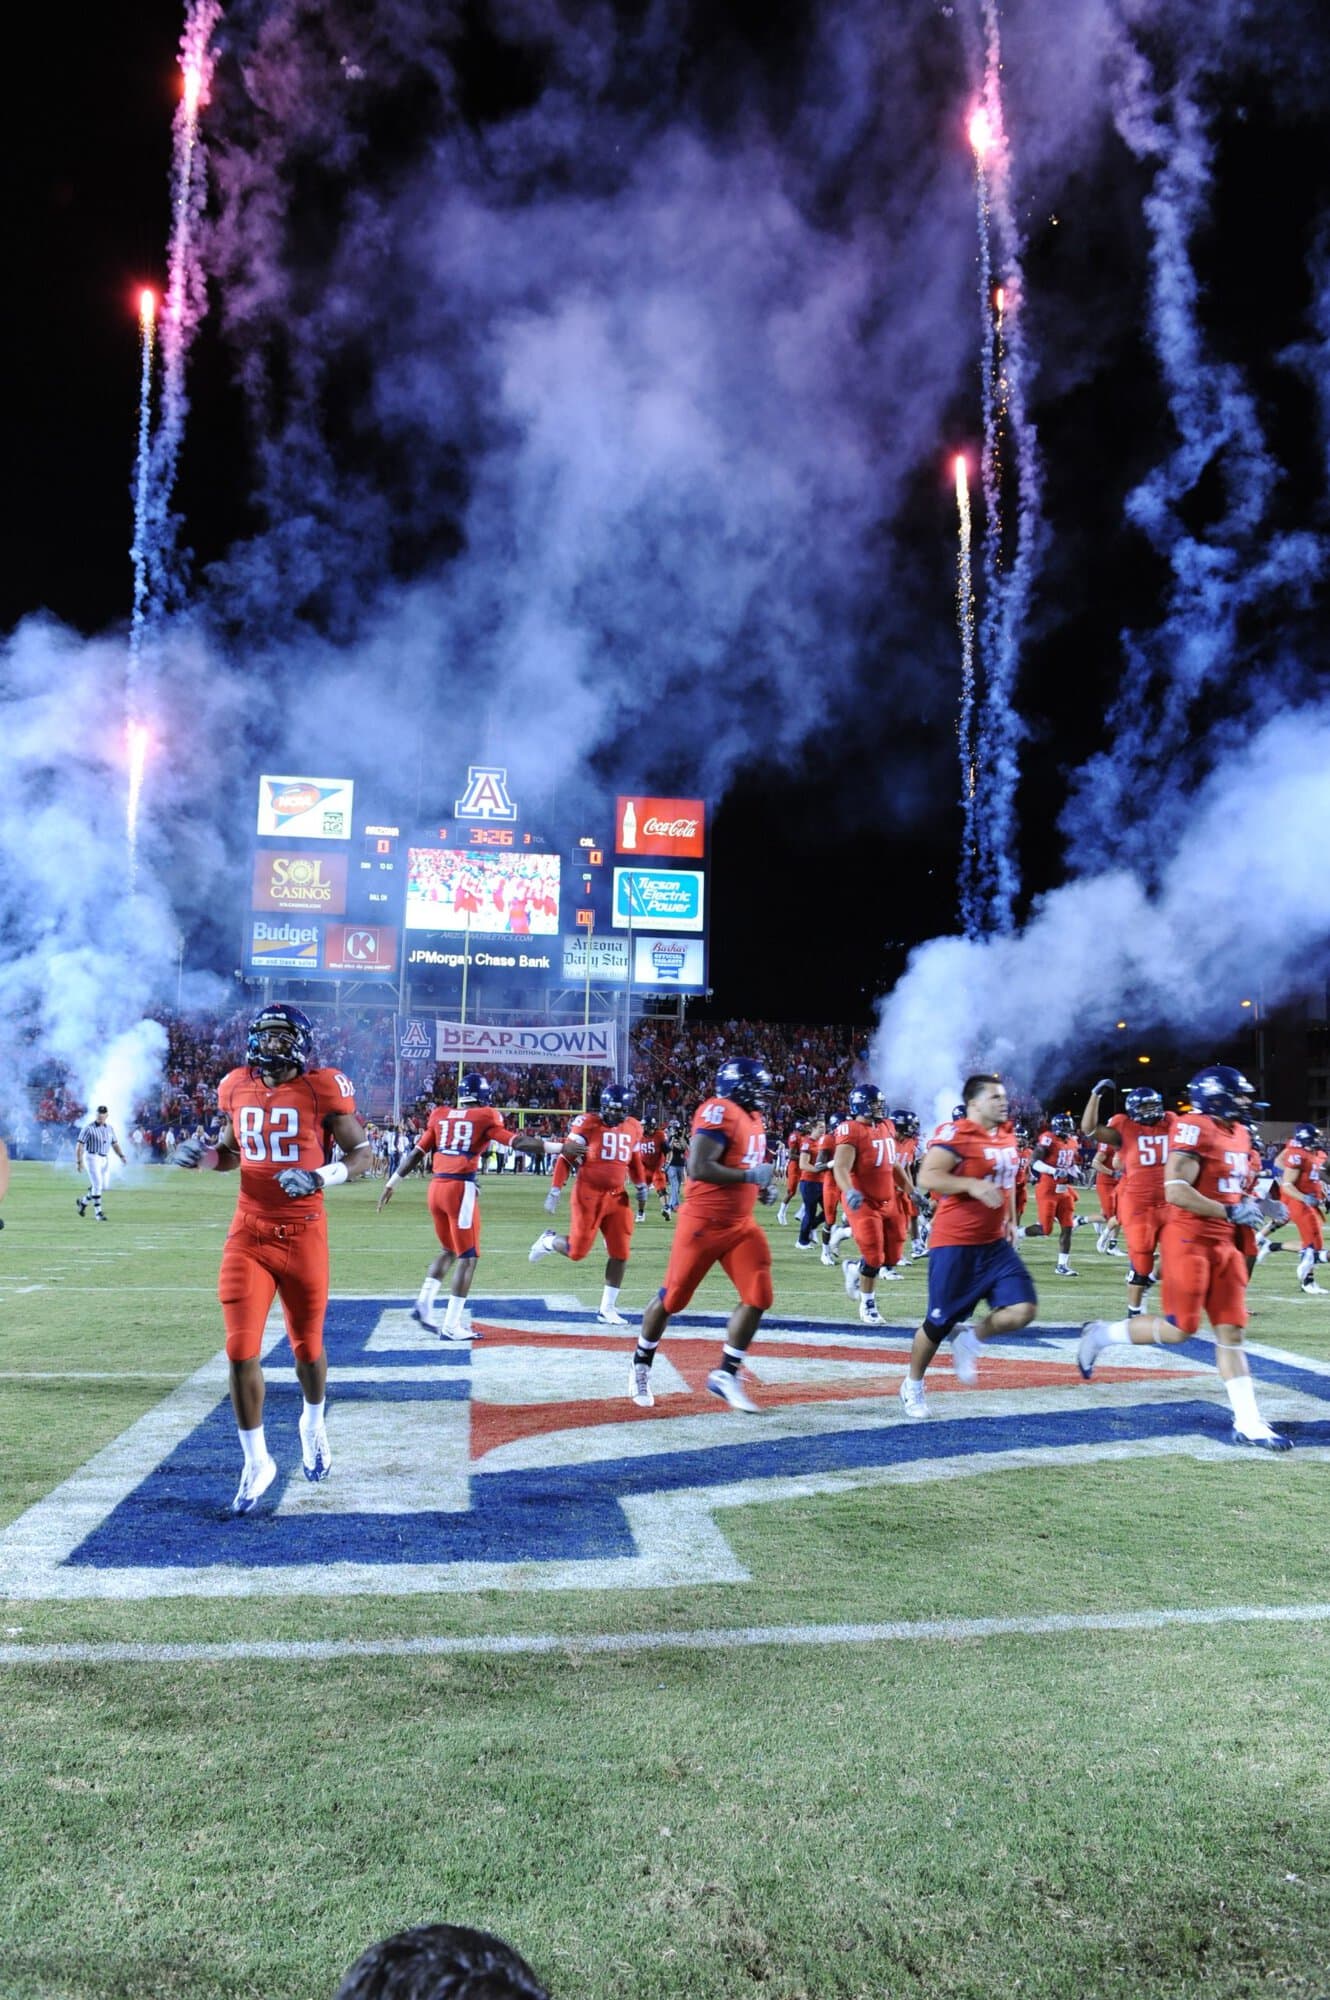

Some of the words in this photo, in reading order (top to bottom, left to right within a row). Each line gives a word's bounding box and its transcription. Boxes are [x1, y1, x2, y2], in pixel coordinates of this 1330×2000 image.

[455, 766, 517, 821] A
[439, 828, 447, 840] 3
[470, 828, 513, 846] 3:26
[643, 817, 699, 838] Coca-Cola
[377, 839, 389, 853] 0
[523, 833, 531, 845] 3
[590, 851, 601, 865] 0
[271, 858, 331, 888] SOL
[270, 886, 331, 901] CASINOS
[638, 877, 681, 892] Tucson
[642, 888, 692, 903] Electric
[647, 900, 692, 914] Power
[253, 921, 319, 947] Budget
[408, 950, 472, 967] JPMorgan
[475, 953, 516, 967] Chase
[519, 955, 550, 969] Bank
[563, 952, 599, 968] Daiy
[520, 1031, 608, 1052] DOWN
[400, 1048, 431, 1058] CLUB
[701, 1103, 726, 1125] 46
[239, 1106, 299, 1163] 82
[437, 1119, 474, 1156] 18
[1174, 1122, 1201, 1146] 38
[601, 1131, 632, 1163] 95
[871, 1136, 897, 1168] 70
[1138, 1134, 1169, 1167] 57
